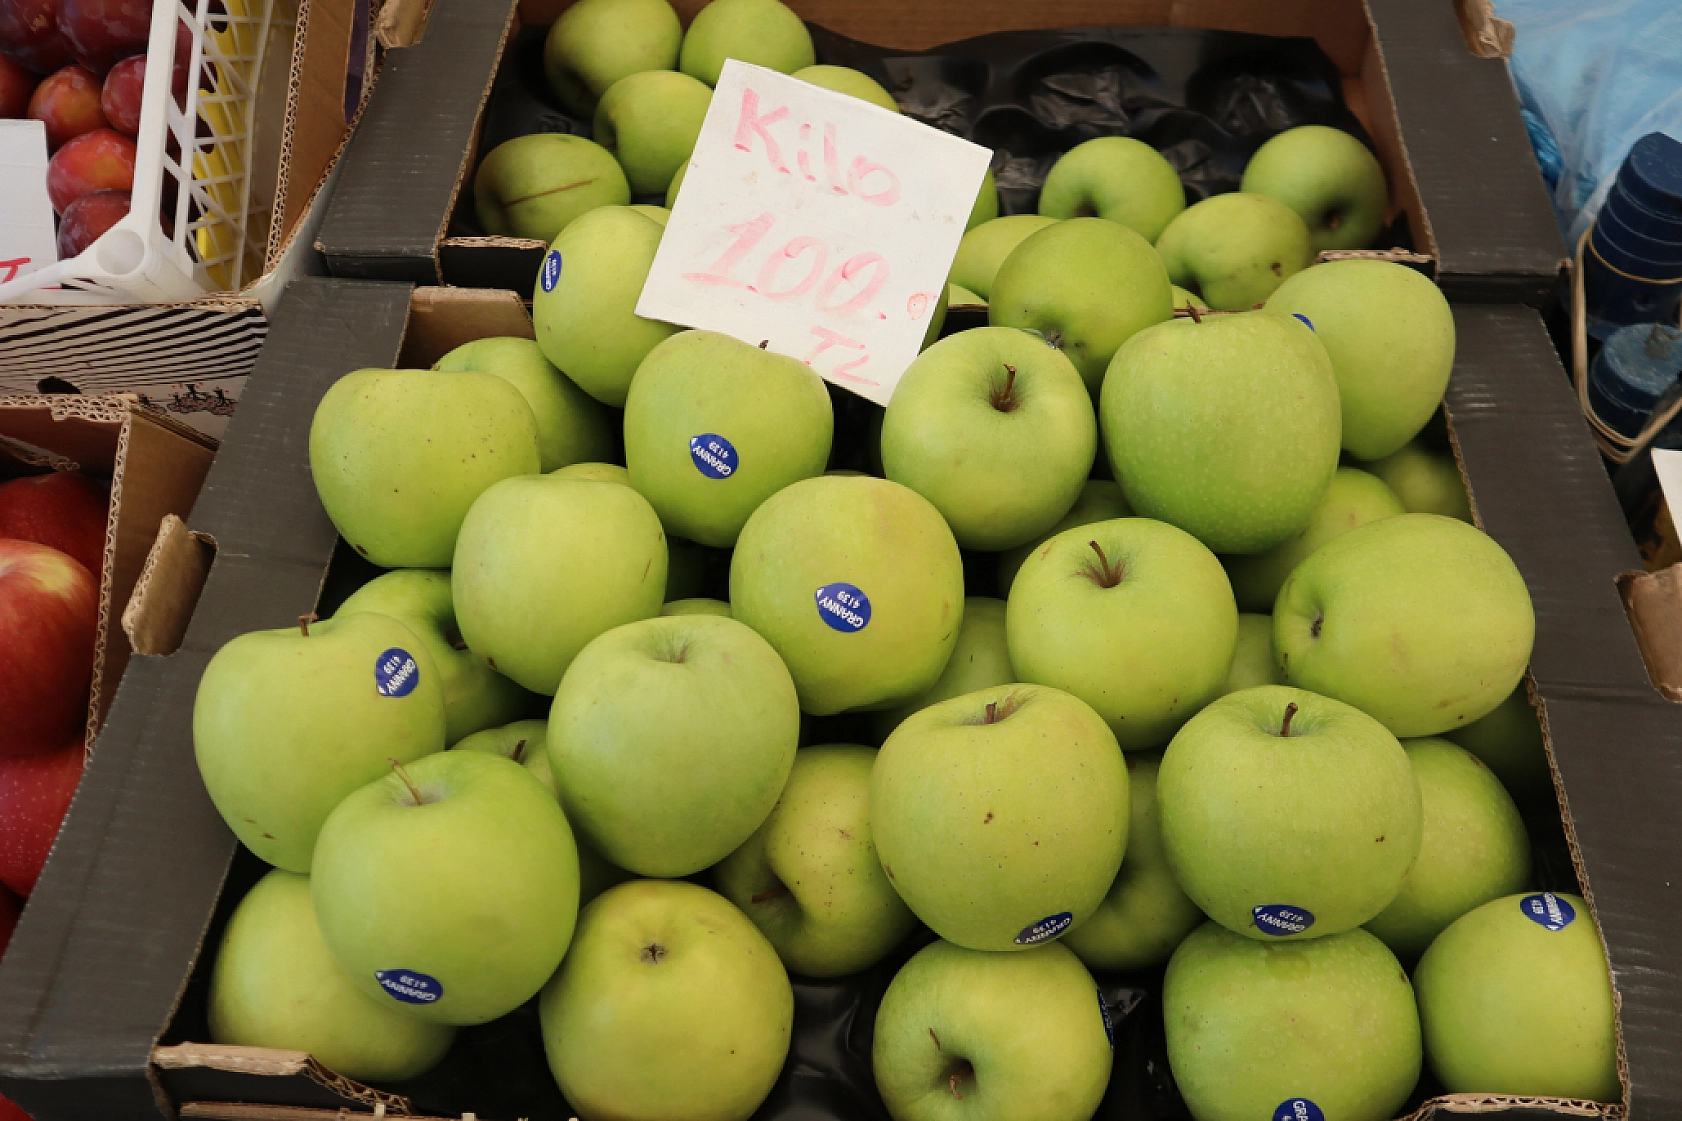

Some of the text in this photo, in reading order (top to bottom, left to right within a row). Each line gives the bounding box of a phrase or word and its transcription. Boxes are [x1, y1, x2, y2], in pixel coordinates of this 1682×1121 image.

[734, 88, 901, 206] Kilo
[692, 445, 731, 476] GRANNY
[709, 441, 729, 458] 4139
[837, 591, 860, 608] 4139
[819, 596, 863, 628] GRANNY
[383, 655, 400, 674] 4139
[386, 658, 415, 695] GRANNY
[1024, 917, 1070, 943] GRANNY
[1257, 913, 1305, 932] GRANNY
[381, 979, 436, 1001] GRANNY
